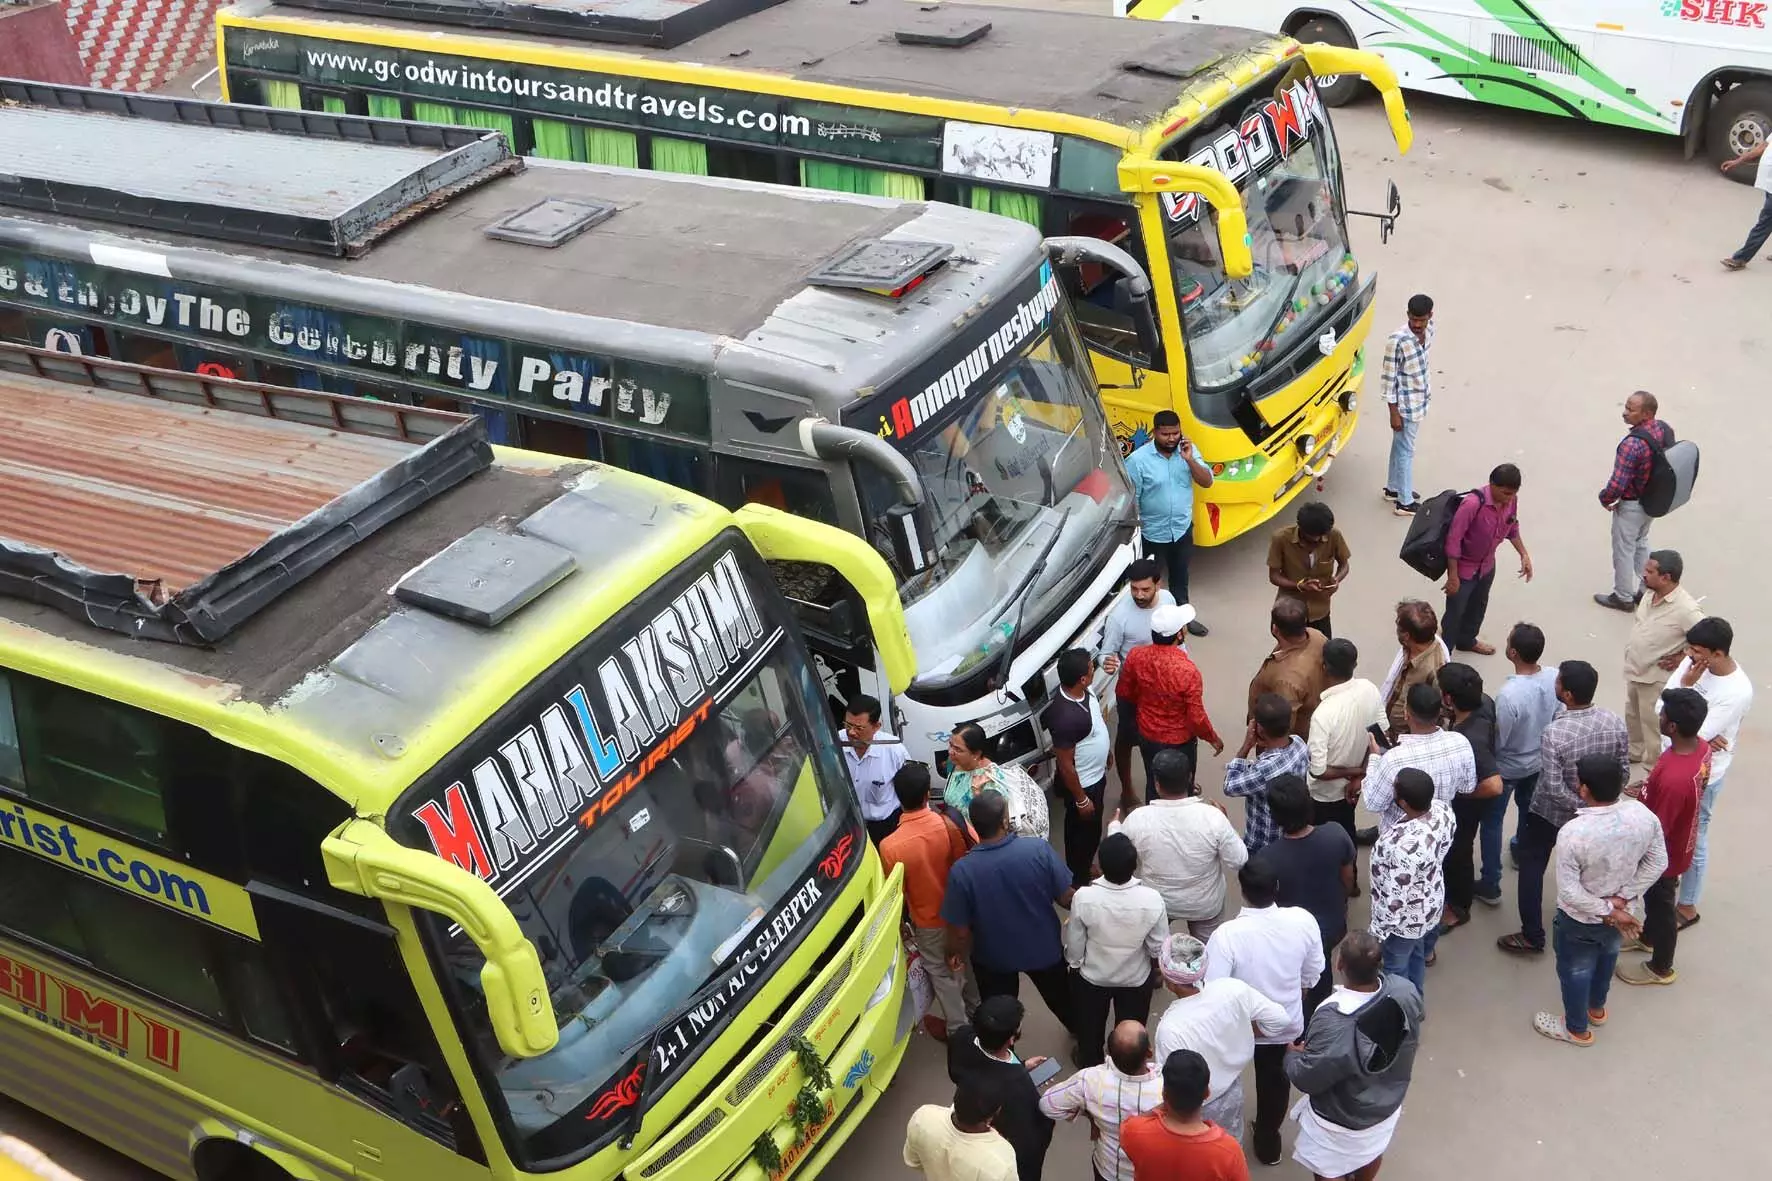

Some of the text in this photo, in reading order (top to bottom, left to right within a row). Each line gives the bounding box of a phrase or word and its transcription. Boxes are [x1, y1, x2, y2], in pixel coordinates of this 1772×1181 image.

[1680, 0, 1768, 29] SHK
[306, 49, 810, 137] www.goodwintoursandtravels.com
[173, 292, 251, 337] The
[518, 356, 673, 426] Party
[413, 549, 764, 886] MAHALAKSHMI
[578, 697, 714, 829] TOURIST
[0, 805, 212, 916] rist.com
[655, 876, 823, 1073] 2+1 NON A/C SLEEPER
